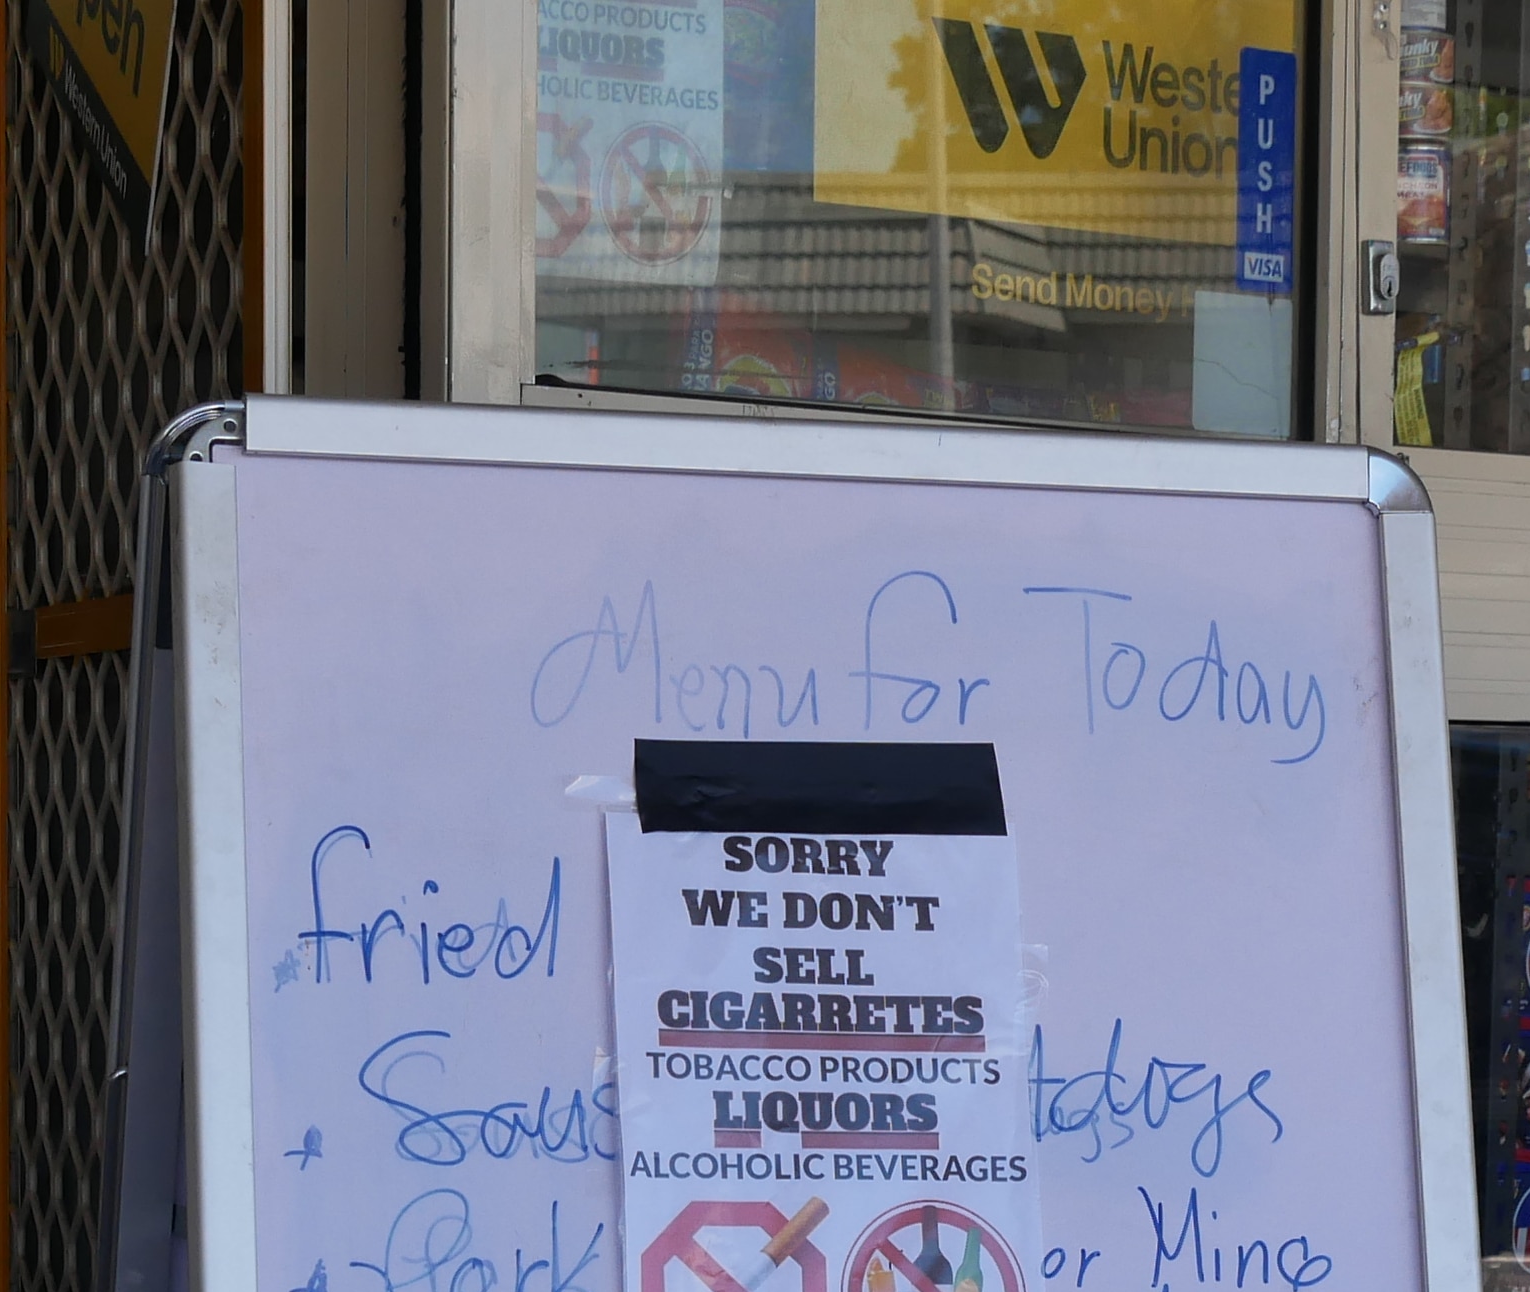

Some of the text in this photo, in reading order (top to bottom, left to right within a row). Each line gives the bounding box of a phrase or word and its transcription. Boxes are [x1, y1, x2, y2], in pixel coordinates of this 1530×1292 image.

[538, 0, 706, 35] ACCO PRODUCTS
[597, 84, 719, 111] BEVERAGES
[1102, 40, 1240, 117] Weste
[64, 58, 128, 200] Western Union
[1255, 74, 1276, 235] PUSH
[1248, 258, 1282, 278] VISA
[972, 262, 1174, 322] Send Money
[531, 579, 818, 738] Menu
[850, 571, 989, 730] for
[722, 836, 894, 877] SORRY
[682, 889, 940, 931] WE DON'T
[752, 946, 874, 986] SELL
[657, 990, 985, 1034] CIGARRETES
[646, 1051, 1000, 1085] TOBACCO PRODUCTS
[713, 1090, 939, 1133] LIQUORS
[630, 1151, 1028, 1183] ALCOHOLIC BEVERAGES
